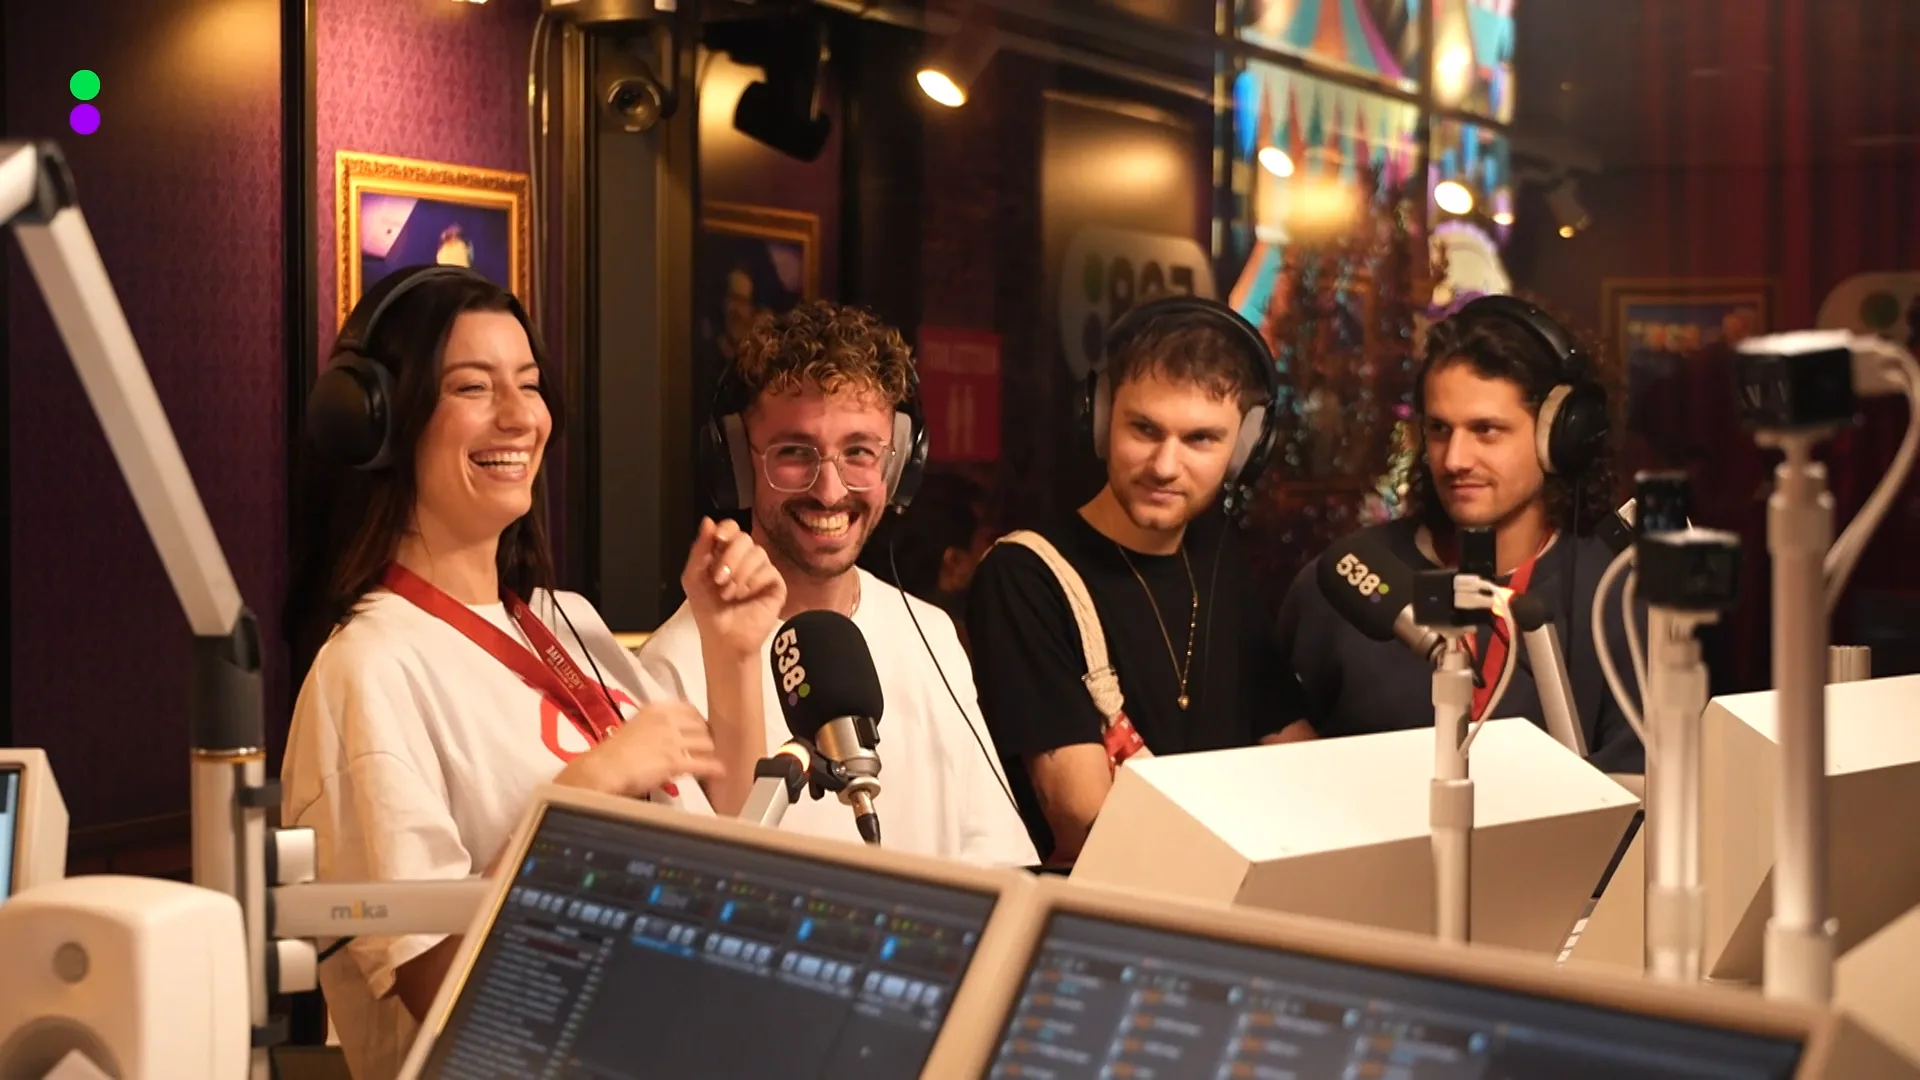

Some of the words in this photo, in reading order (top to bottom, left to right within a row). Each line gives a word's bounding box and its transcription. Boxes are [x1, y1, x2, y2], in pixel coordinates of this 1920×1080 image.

[1336, 553, 1380, 596] 538
[774, 627, 806, 693] 538
[331, 900, 389, 920] mika
